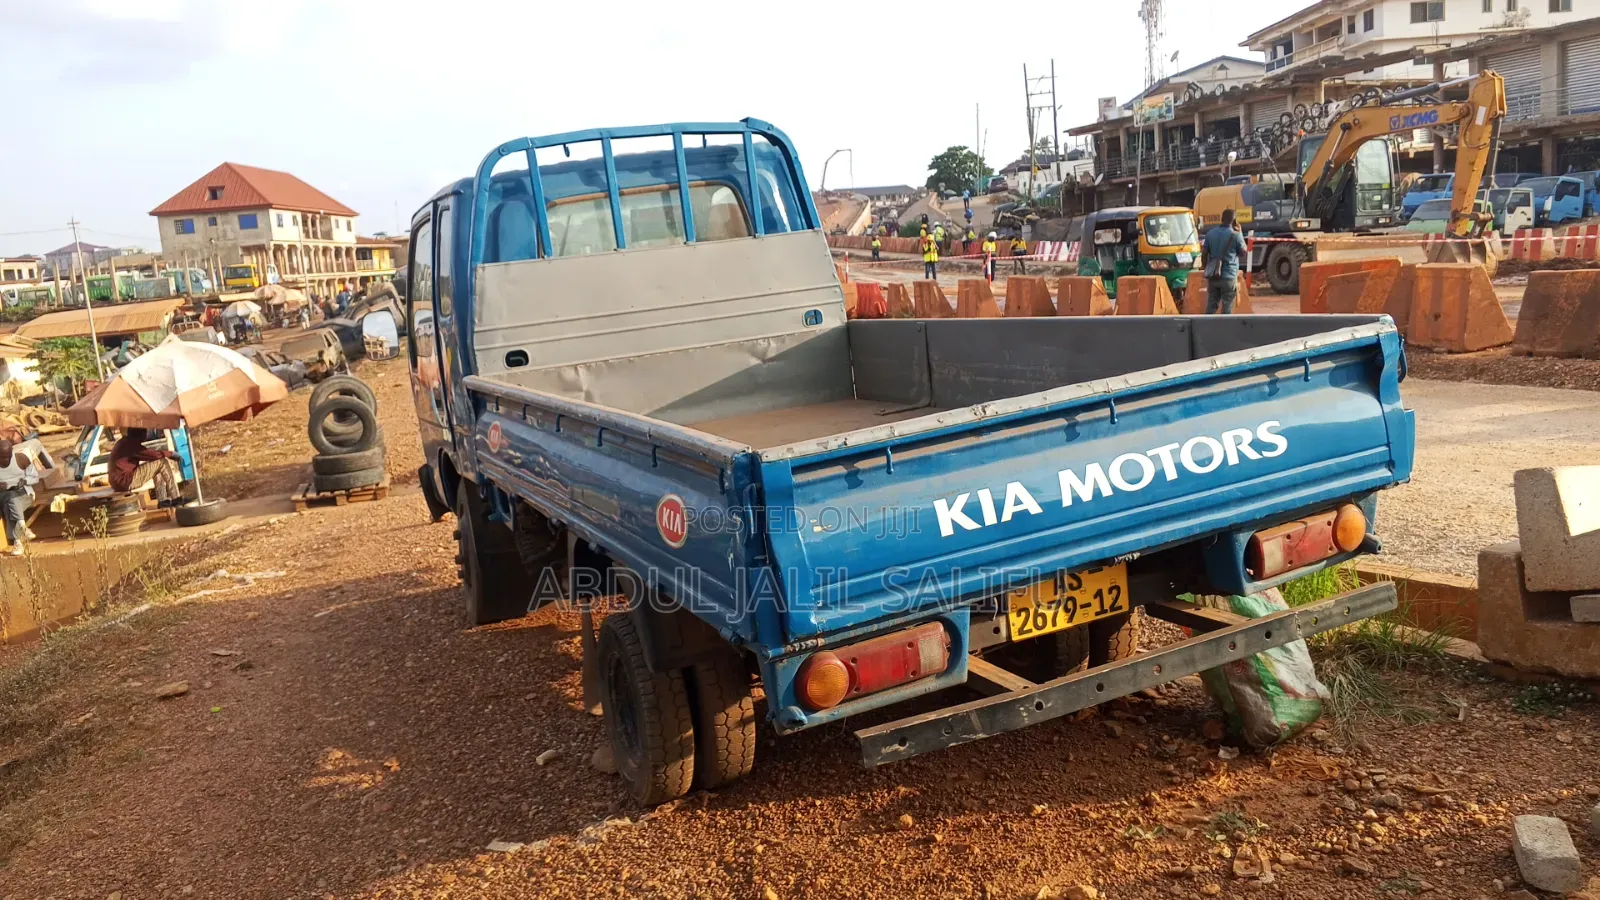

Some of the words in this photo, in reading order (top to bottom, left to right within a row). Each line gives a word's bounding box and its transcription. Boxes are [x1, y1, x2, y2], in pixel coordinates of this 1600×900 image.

[1401, 109, 1439, 128] XCMG
[932, 481, 1044, 537] KIA
[1057, 420, 1288, 507] MOTORS
[662, 506, 682, 536] KIA
[1016, 584, 1123, 636] 2679-12
